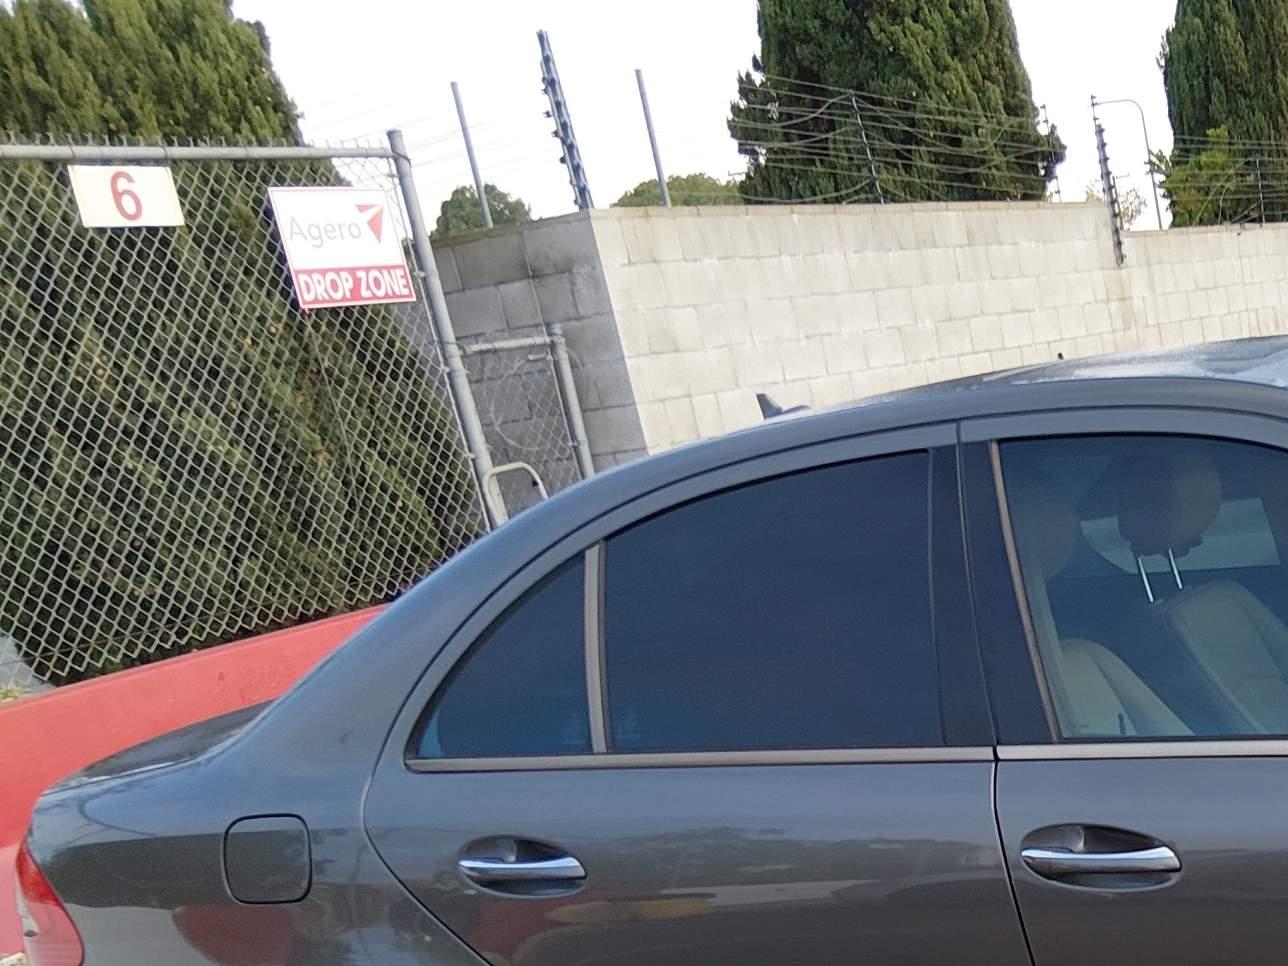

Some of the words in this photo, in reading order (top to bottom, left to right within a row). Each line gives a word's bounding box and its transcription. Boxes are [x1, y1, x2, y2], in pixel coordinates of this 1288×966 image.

[110, 171, 143, 221] 6
[289, 216, 362, 248] Agero
[298, 271, 354, 301] DROP
[356, 269, 409, 298] ZONE
